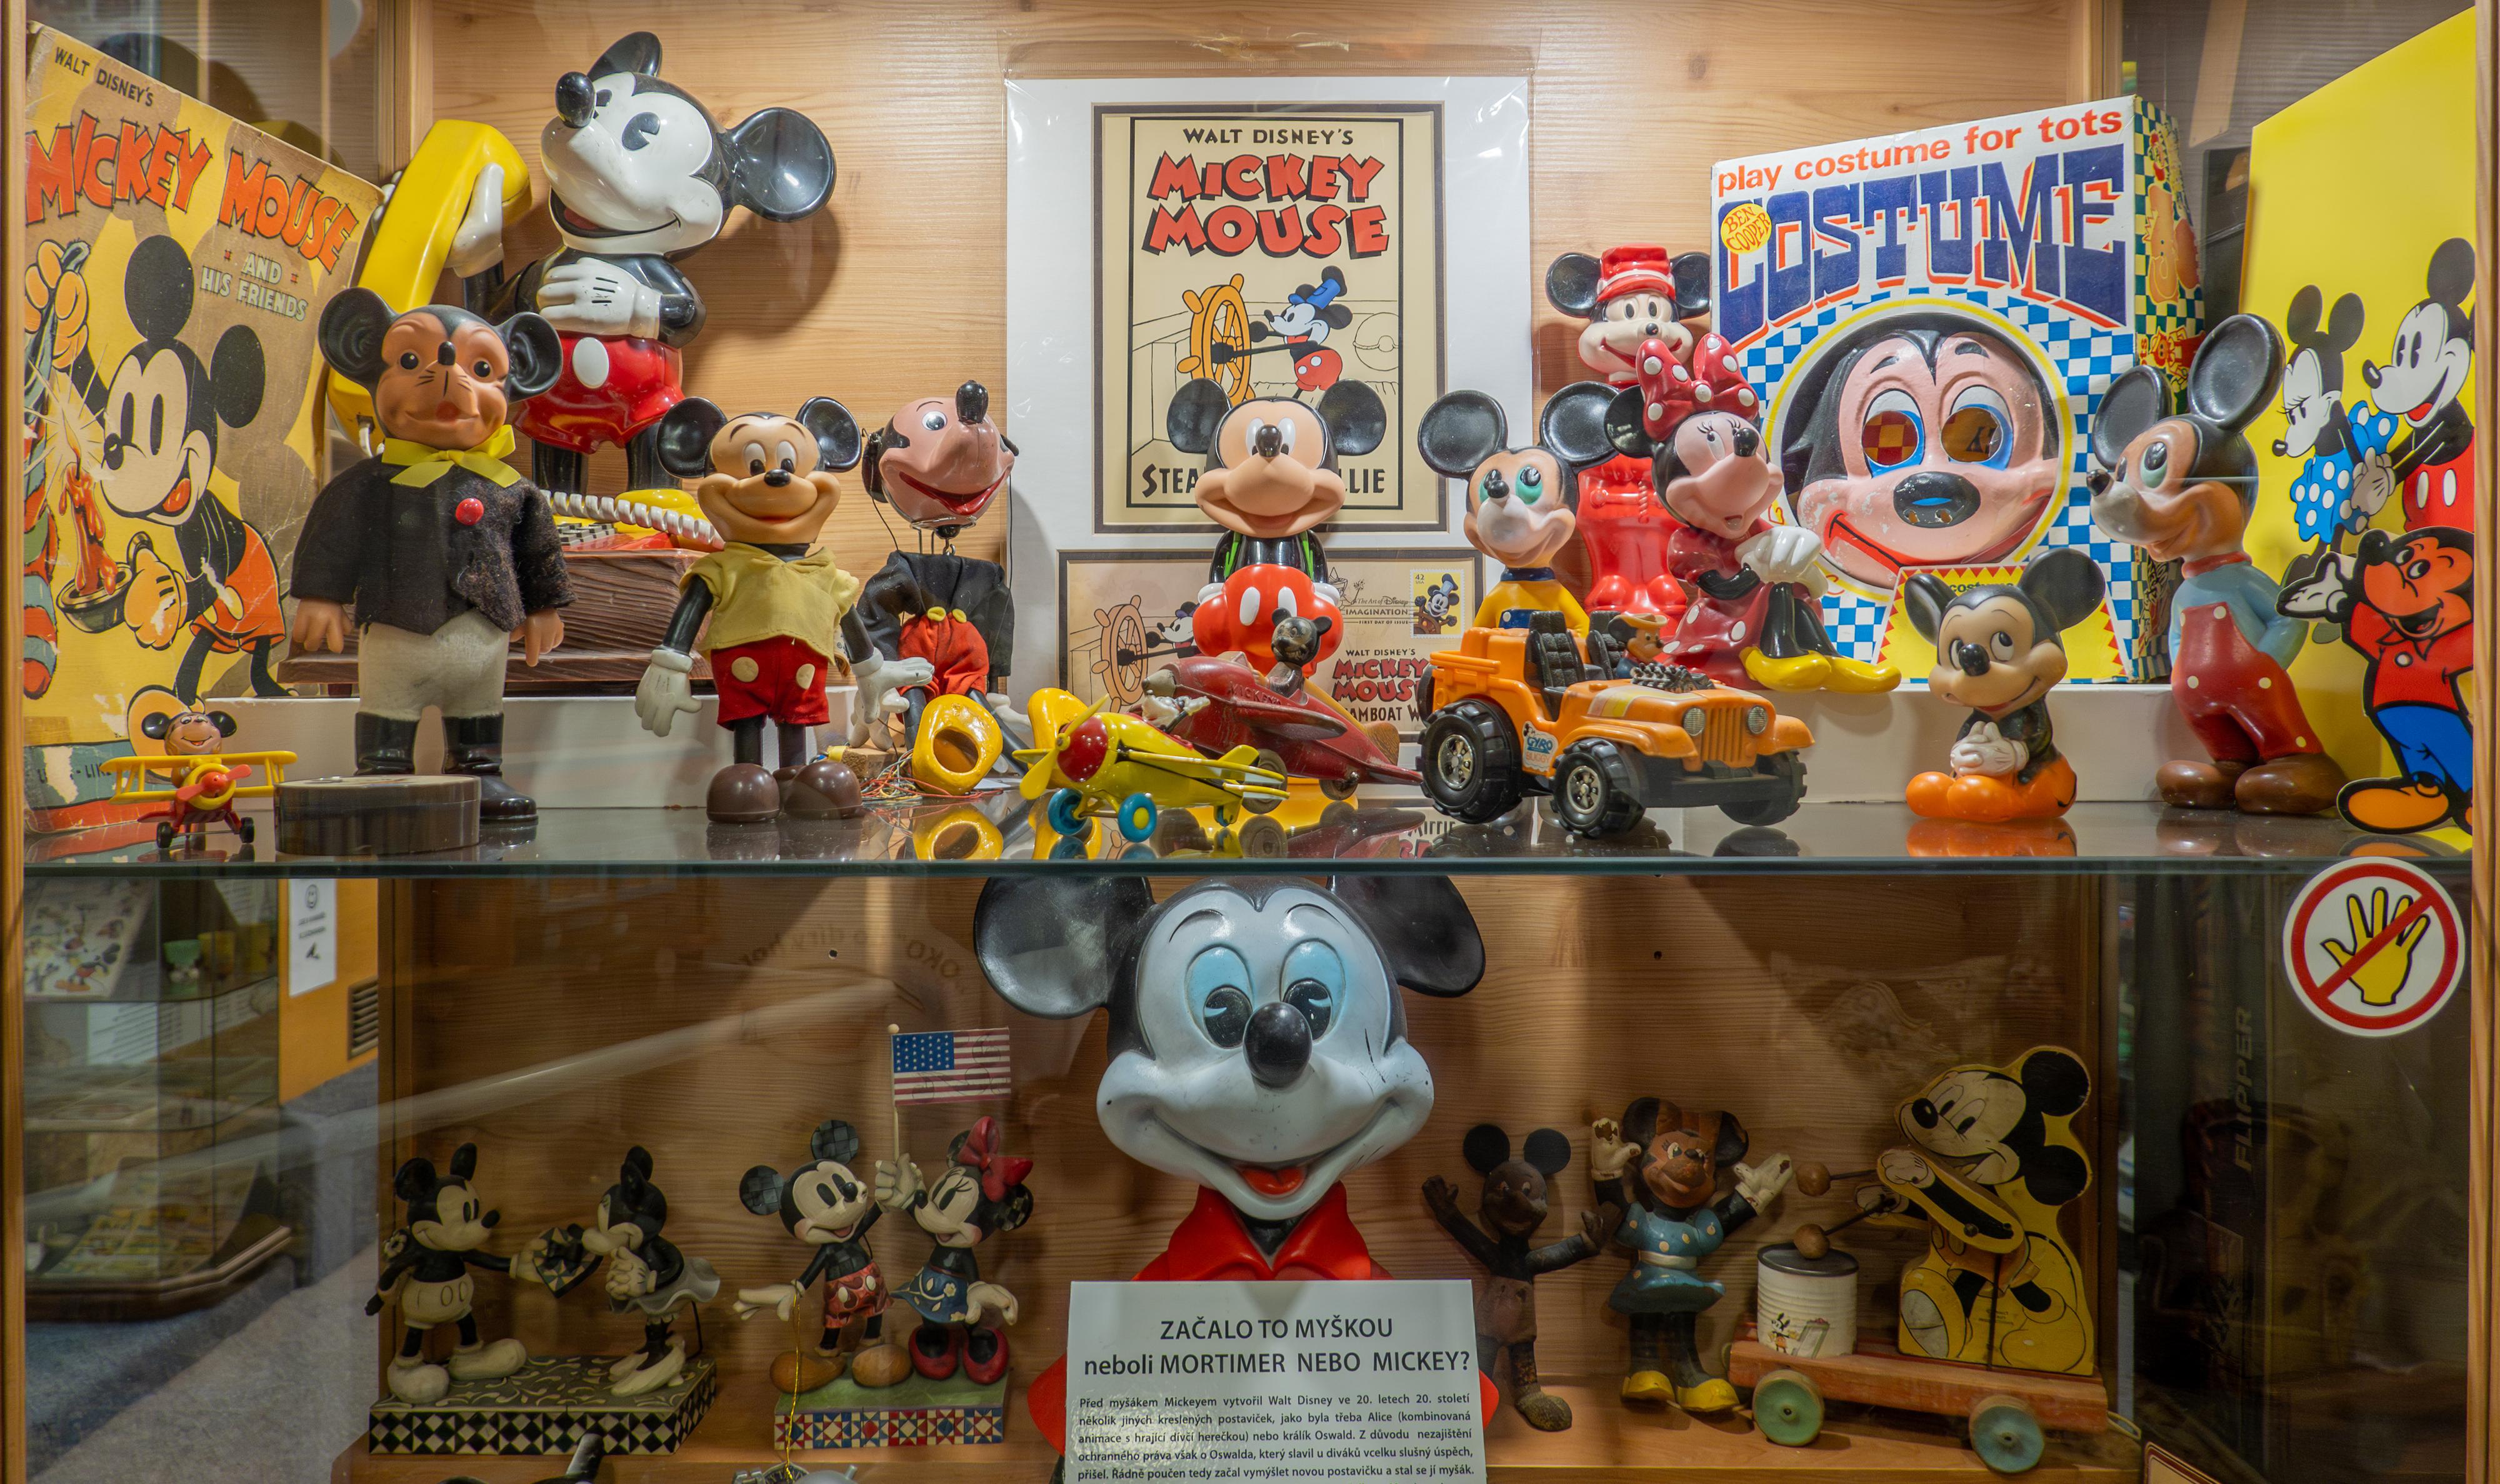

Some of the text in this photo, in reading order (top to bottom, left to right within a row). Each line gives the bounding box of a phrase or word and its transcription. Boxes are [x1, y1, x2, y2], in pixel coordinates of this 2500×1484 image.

[54, 46, 154, 107] WALT DISNEY'S
[1183, 127, 1354, 145] WALT DISNEY'S
[1718, 108, 2122, 197] play costume for tots
[1147, 151, 1385, 203] MICKEY
[26, 109, 359, 274] MICKEY MOUSE
[1141, 201, 1390, 259] MOUSE
[1724, 206, 1756, 234] BEN
[1726, 212, 1771, 251] COOPER
[1719, 144, 2126, 345] COSTUME
[241, 251, 282, 285] AND
[200, 266, 309, 322] HIS FRIENDS
[1383, 596, 1408, 607] Disney
[1332, 657, 1430, 679] MICKEY
[1331, 679, 1421, 702] MOUS
[1527, 737, 1552, 750] GYRO
[2235, 1006, 2252, 1172] FLIPPER
[1161, 1315, 1392, 1340] ZAČALO TO MYŠKOU
[1084, 1351, 1470, 1375] neboli MORTIMER NEBO MICKEY?
[1080, 1392, 1469, 1410] Před myšákem Mickeyem vytvořil Walt Disney ve 20. letech 20. století
[1080, 1410, 1470, 1427] několik jiných kreslených postaviček, jako byla třeba Alice (kombinovaná
[1079, 1427, 1472, 1445] animace s hrající dívčí herečkou) nebo králík Oswald. Z důvodu nezajištění
[1078, 1445, 1472, 1463] ochranného práva však o Oswalda, který slavil u diváků vcelku slušný úspěch,
[1078, 1463, 1474, 1482] přišel. Řádně poučen tedy začal vymýšlet novou postavičku a stal se jí myšák.
